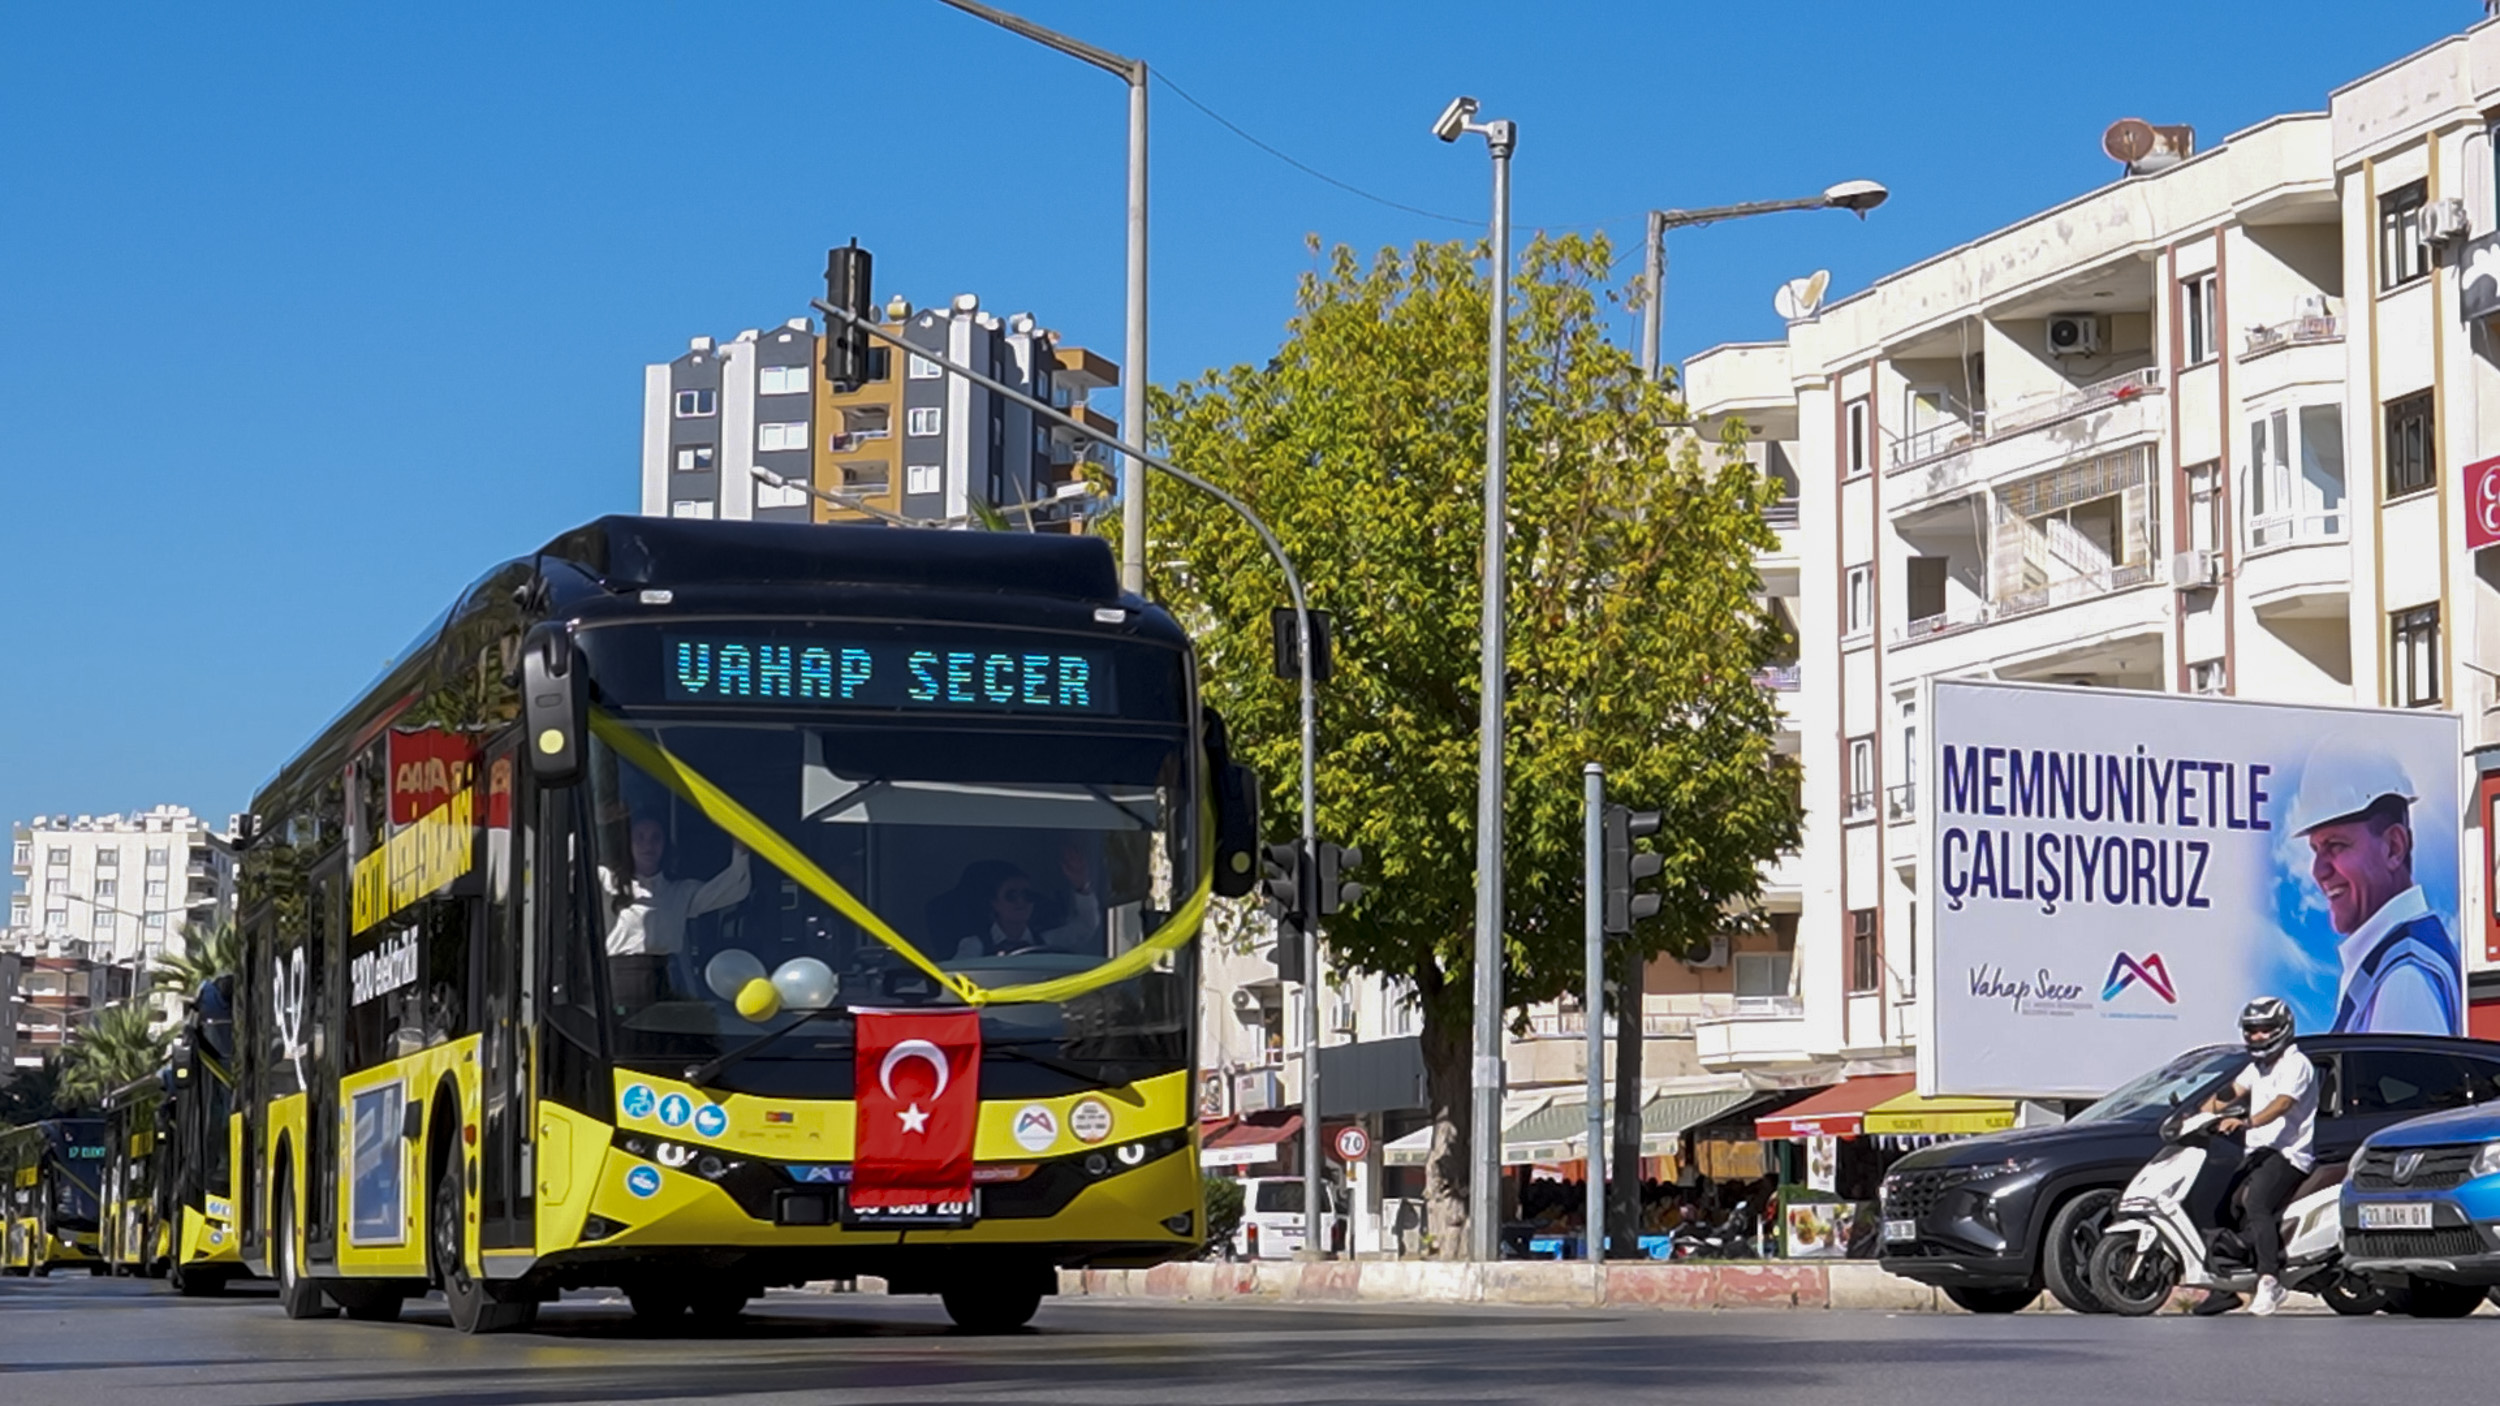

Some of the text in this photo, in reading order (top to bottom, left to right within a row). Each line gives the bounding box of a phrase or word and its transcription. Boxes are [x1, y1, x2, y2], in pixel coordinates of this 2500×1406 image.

[678, 642, 1090, 706] VAHAP SECER
[1942, 744, 2272, 831] MEMNUNİYETLE
[1942, 827, 2210, 915] ÇALIŞIYORUZ
[1969, 962, 2031, 1013] Vahap
[1344, 1135, 1363, 1151] 70
